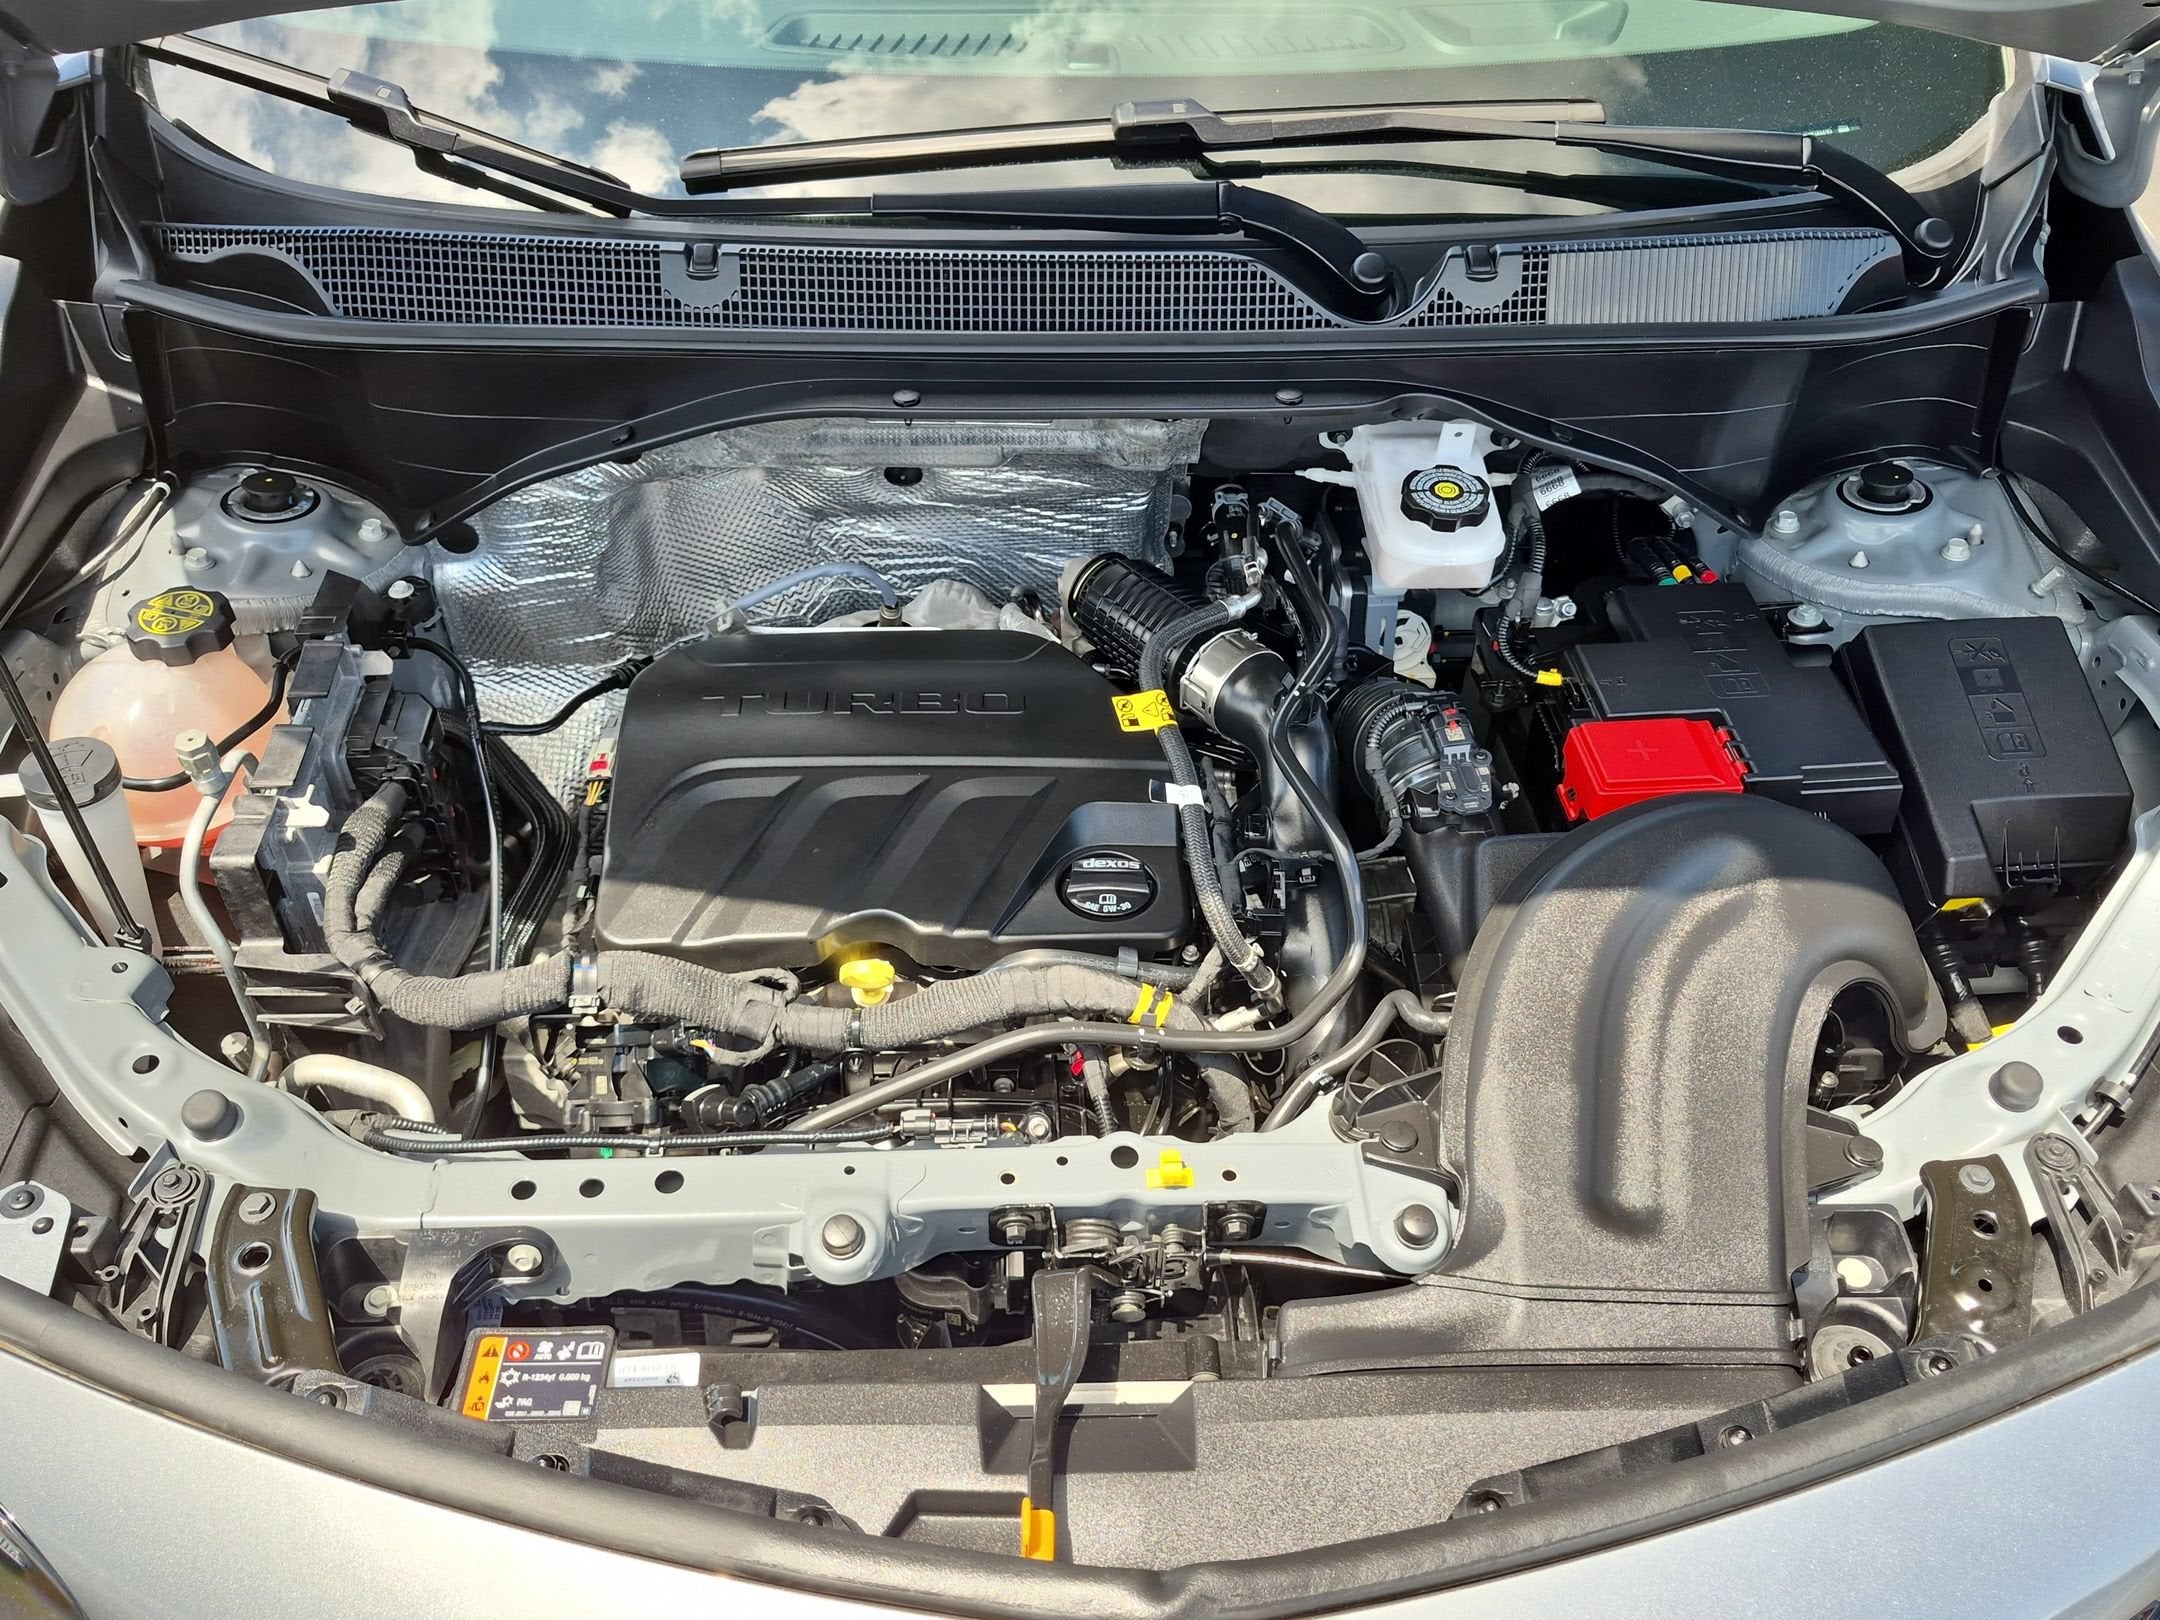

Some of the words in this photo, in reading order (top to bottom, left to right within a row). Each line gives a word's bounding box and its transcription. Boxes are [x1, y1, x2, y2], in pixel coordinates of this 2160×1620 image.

[701, 691, 1026, 717] TURBO
[1085, 901, 1100, 912] SAE
[1102, 901, 1132, 913] 5W-30
[533, 1353, 552, 1361] AUTO
[580, 1373, 592, 1382] kg
